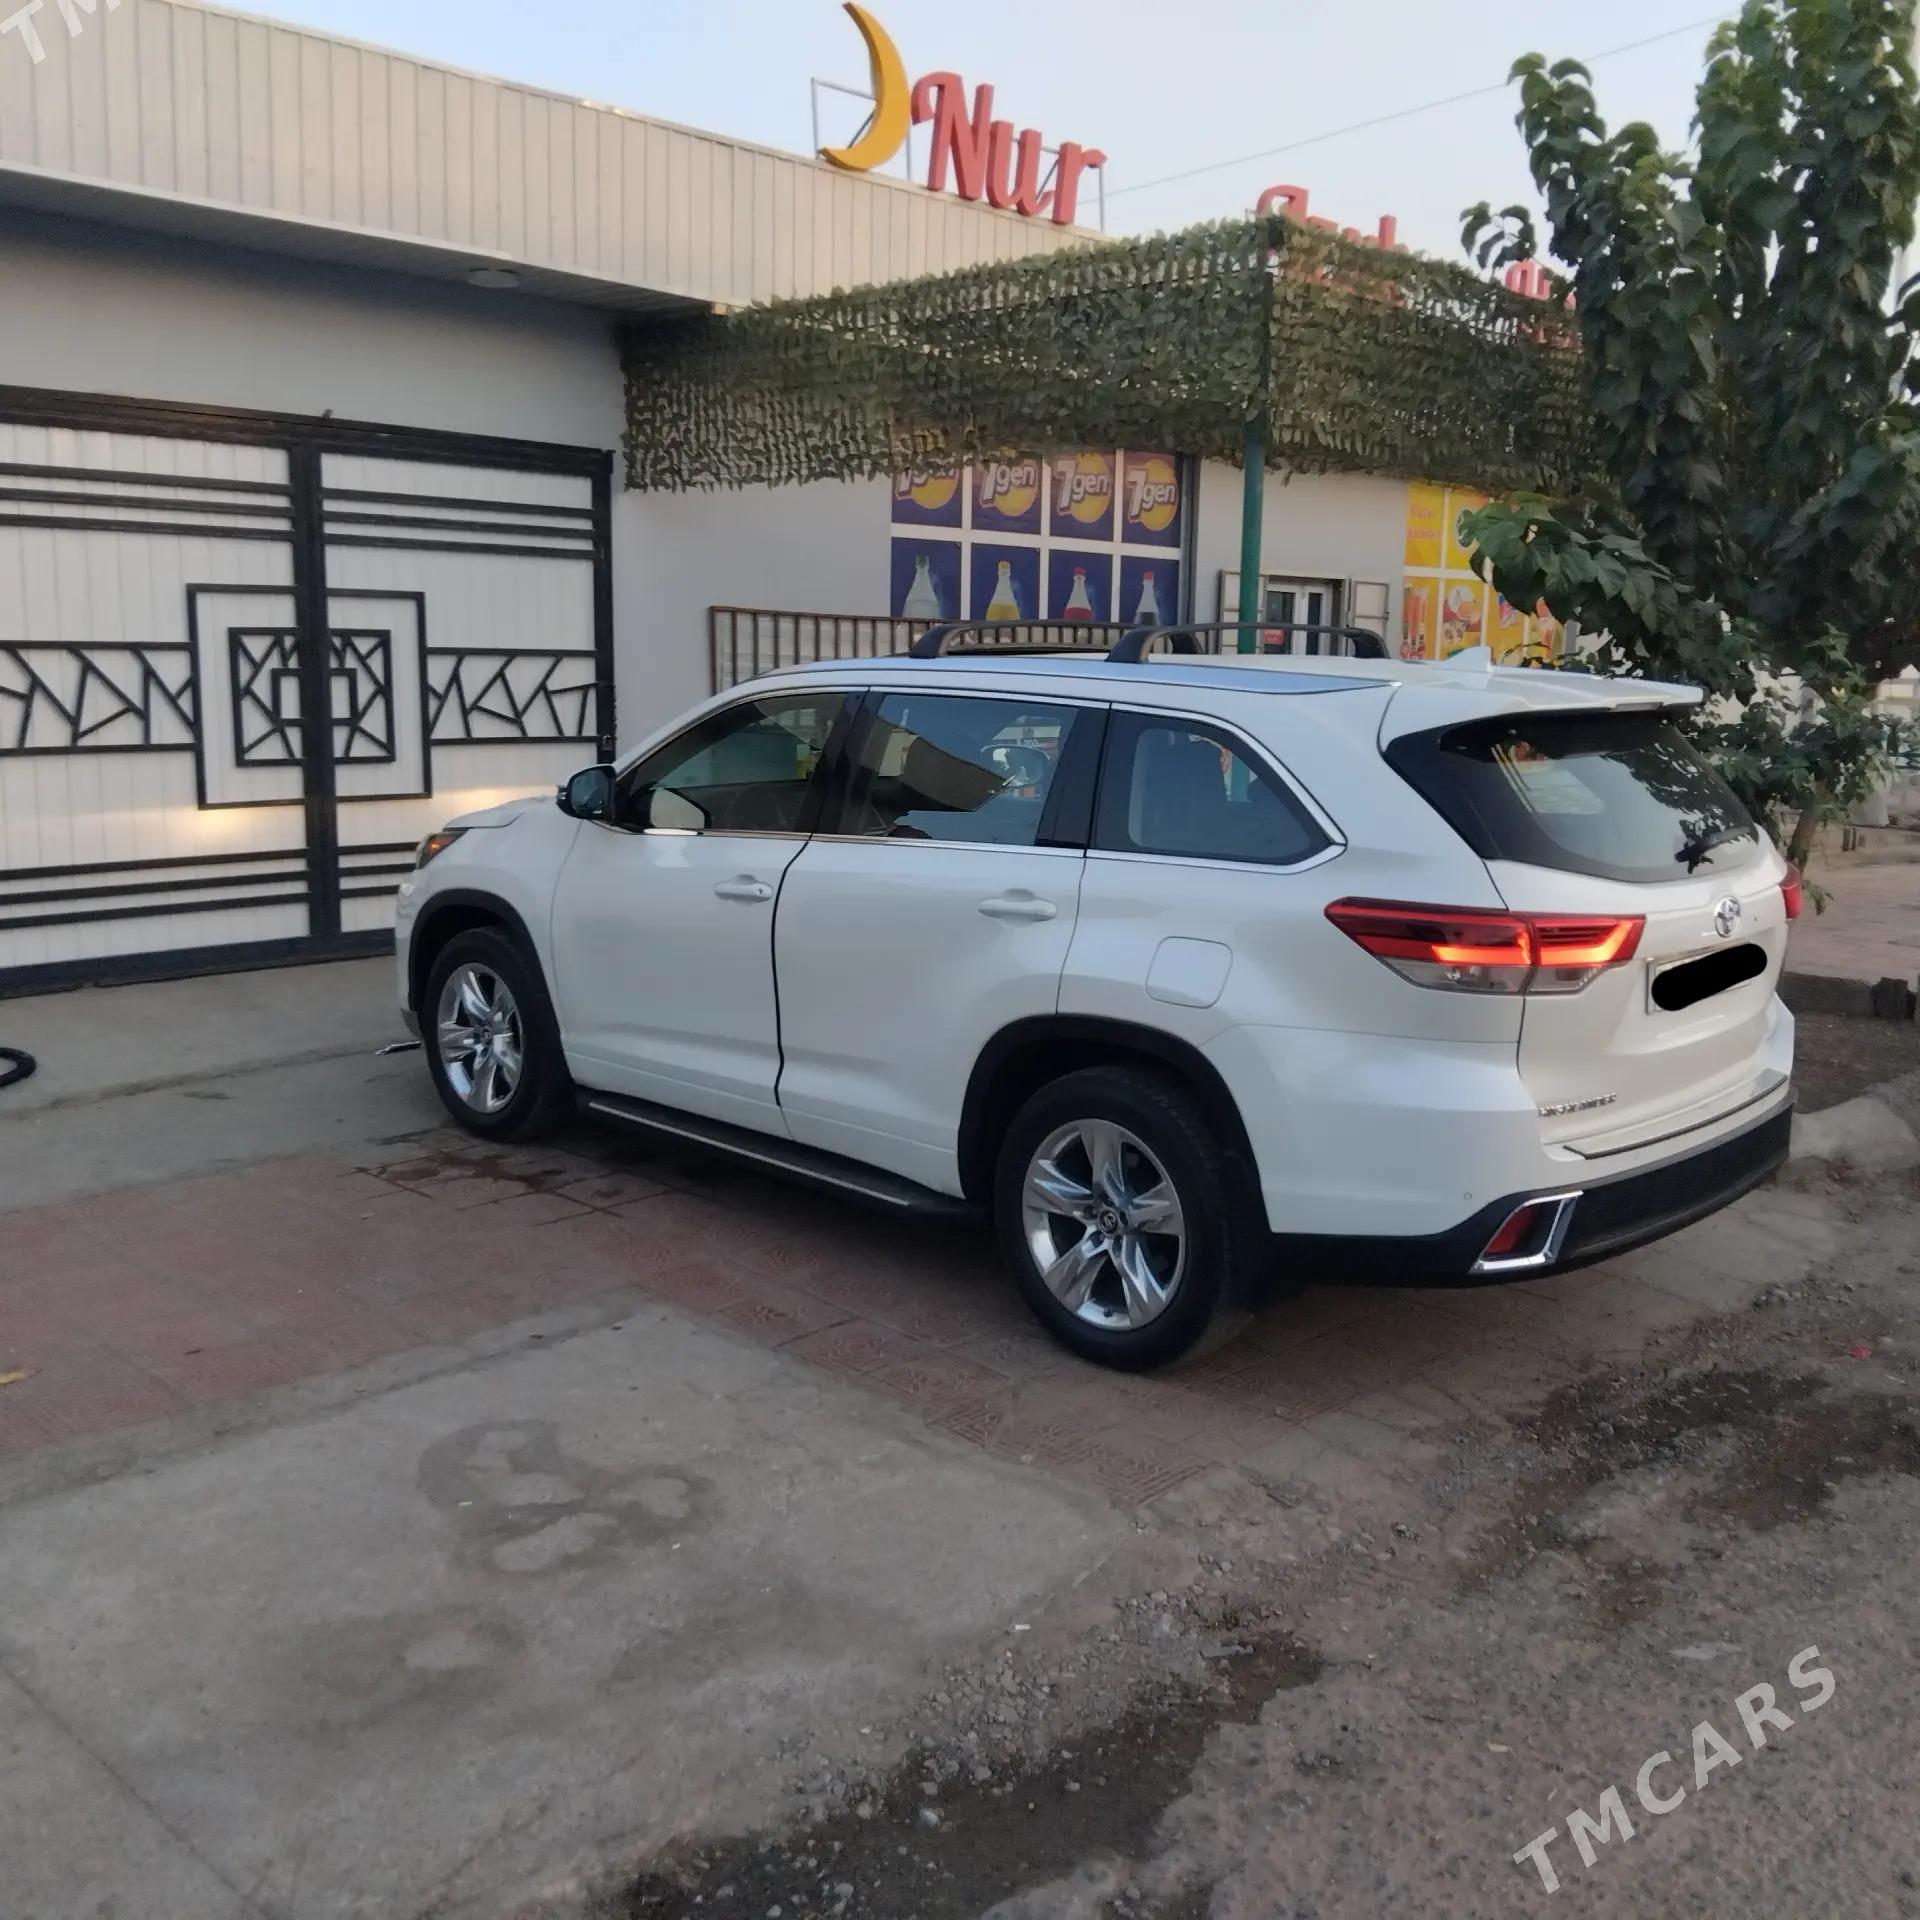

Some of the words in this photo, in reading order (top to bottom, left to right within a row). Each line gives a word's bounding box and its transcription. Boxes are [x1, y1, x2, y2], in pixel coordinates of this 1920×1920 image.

[911, 71, 1107, 225] Nur
[1053, 459, 1109, 509] 7gen
[1127, 468, 1176, 518] 7gen
